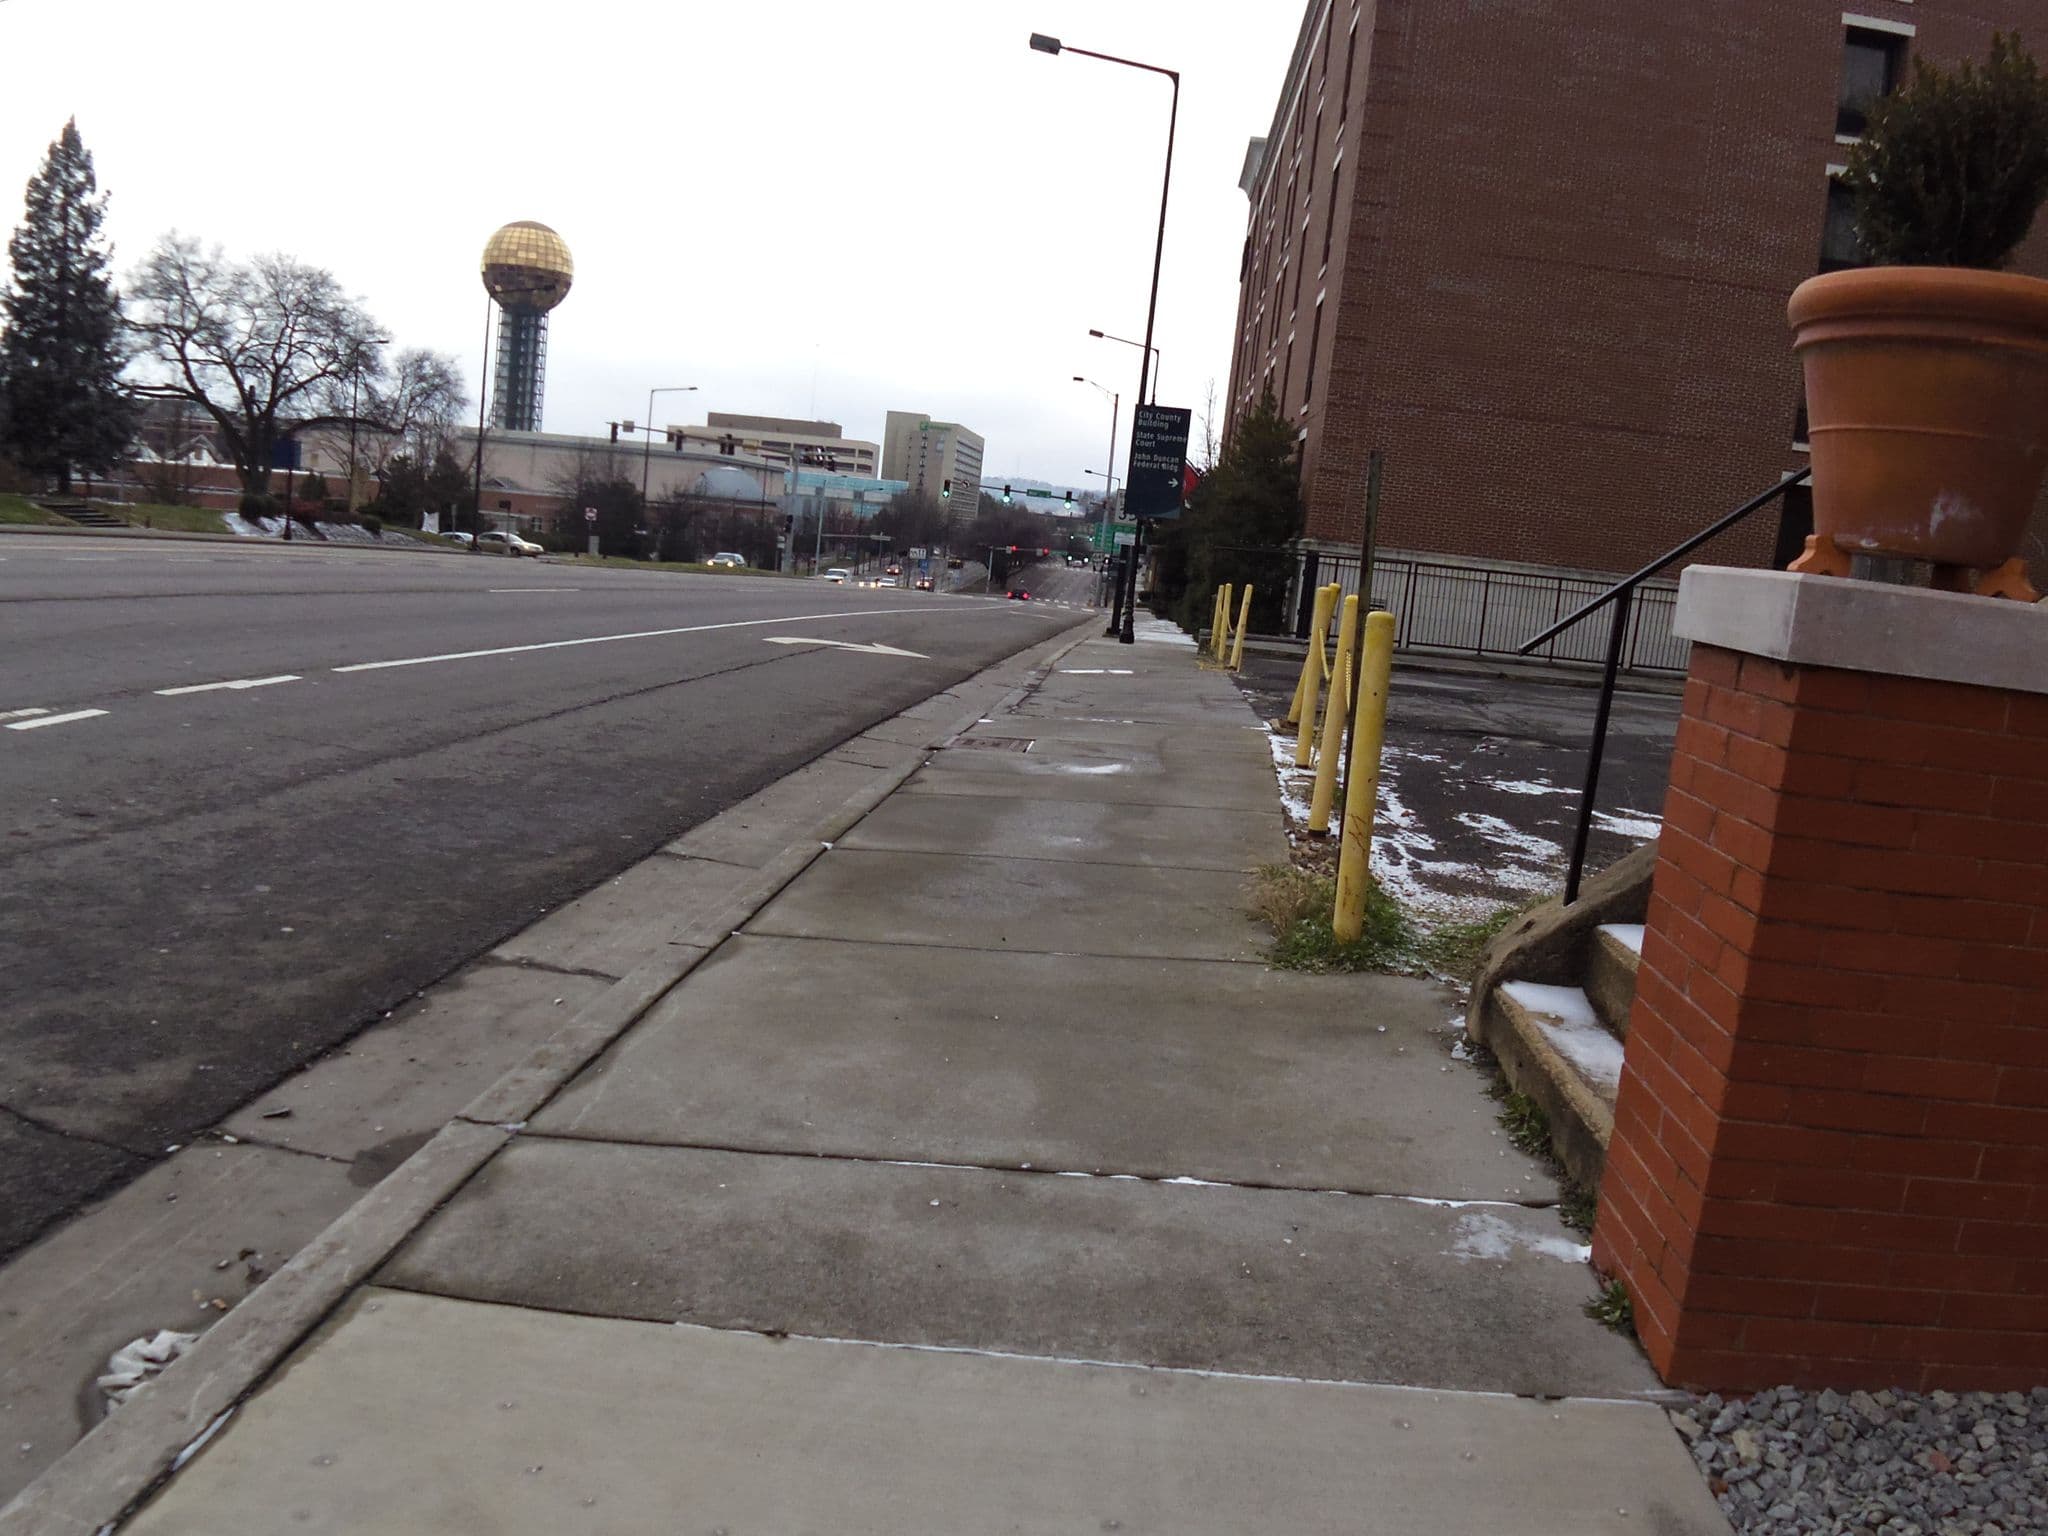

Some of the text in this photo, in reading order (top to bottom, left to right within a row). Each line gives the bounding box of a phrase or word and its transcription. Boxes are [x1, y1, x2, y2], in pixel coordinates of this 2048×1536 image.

[1139, 410, 1181, 423] City County
[1138, 419, 1168, 430] Building
[1156, 433, 1186, 442] Supreme
[1136, 439, 1155, 447] Court
[1153, 454, 1179, 463] Duncan
[1133, 460, 1160, 469] Federal
